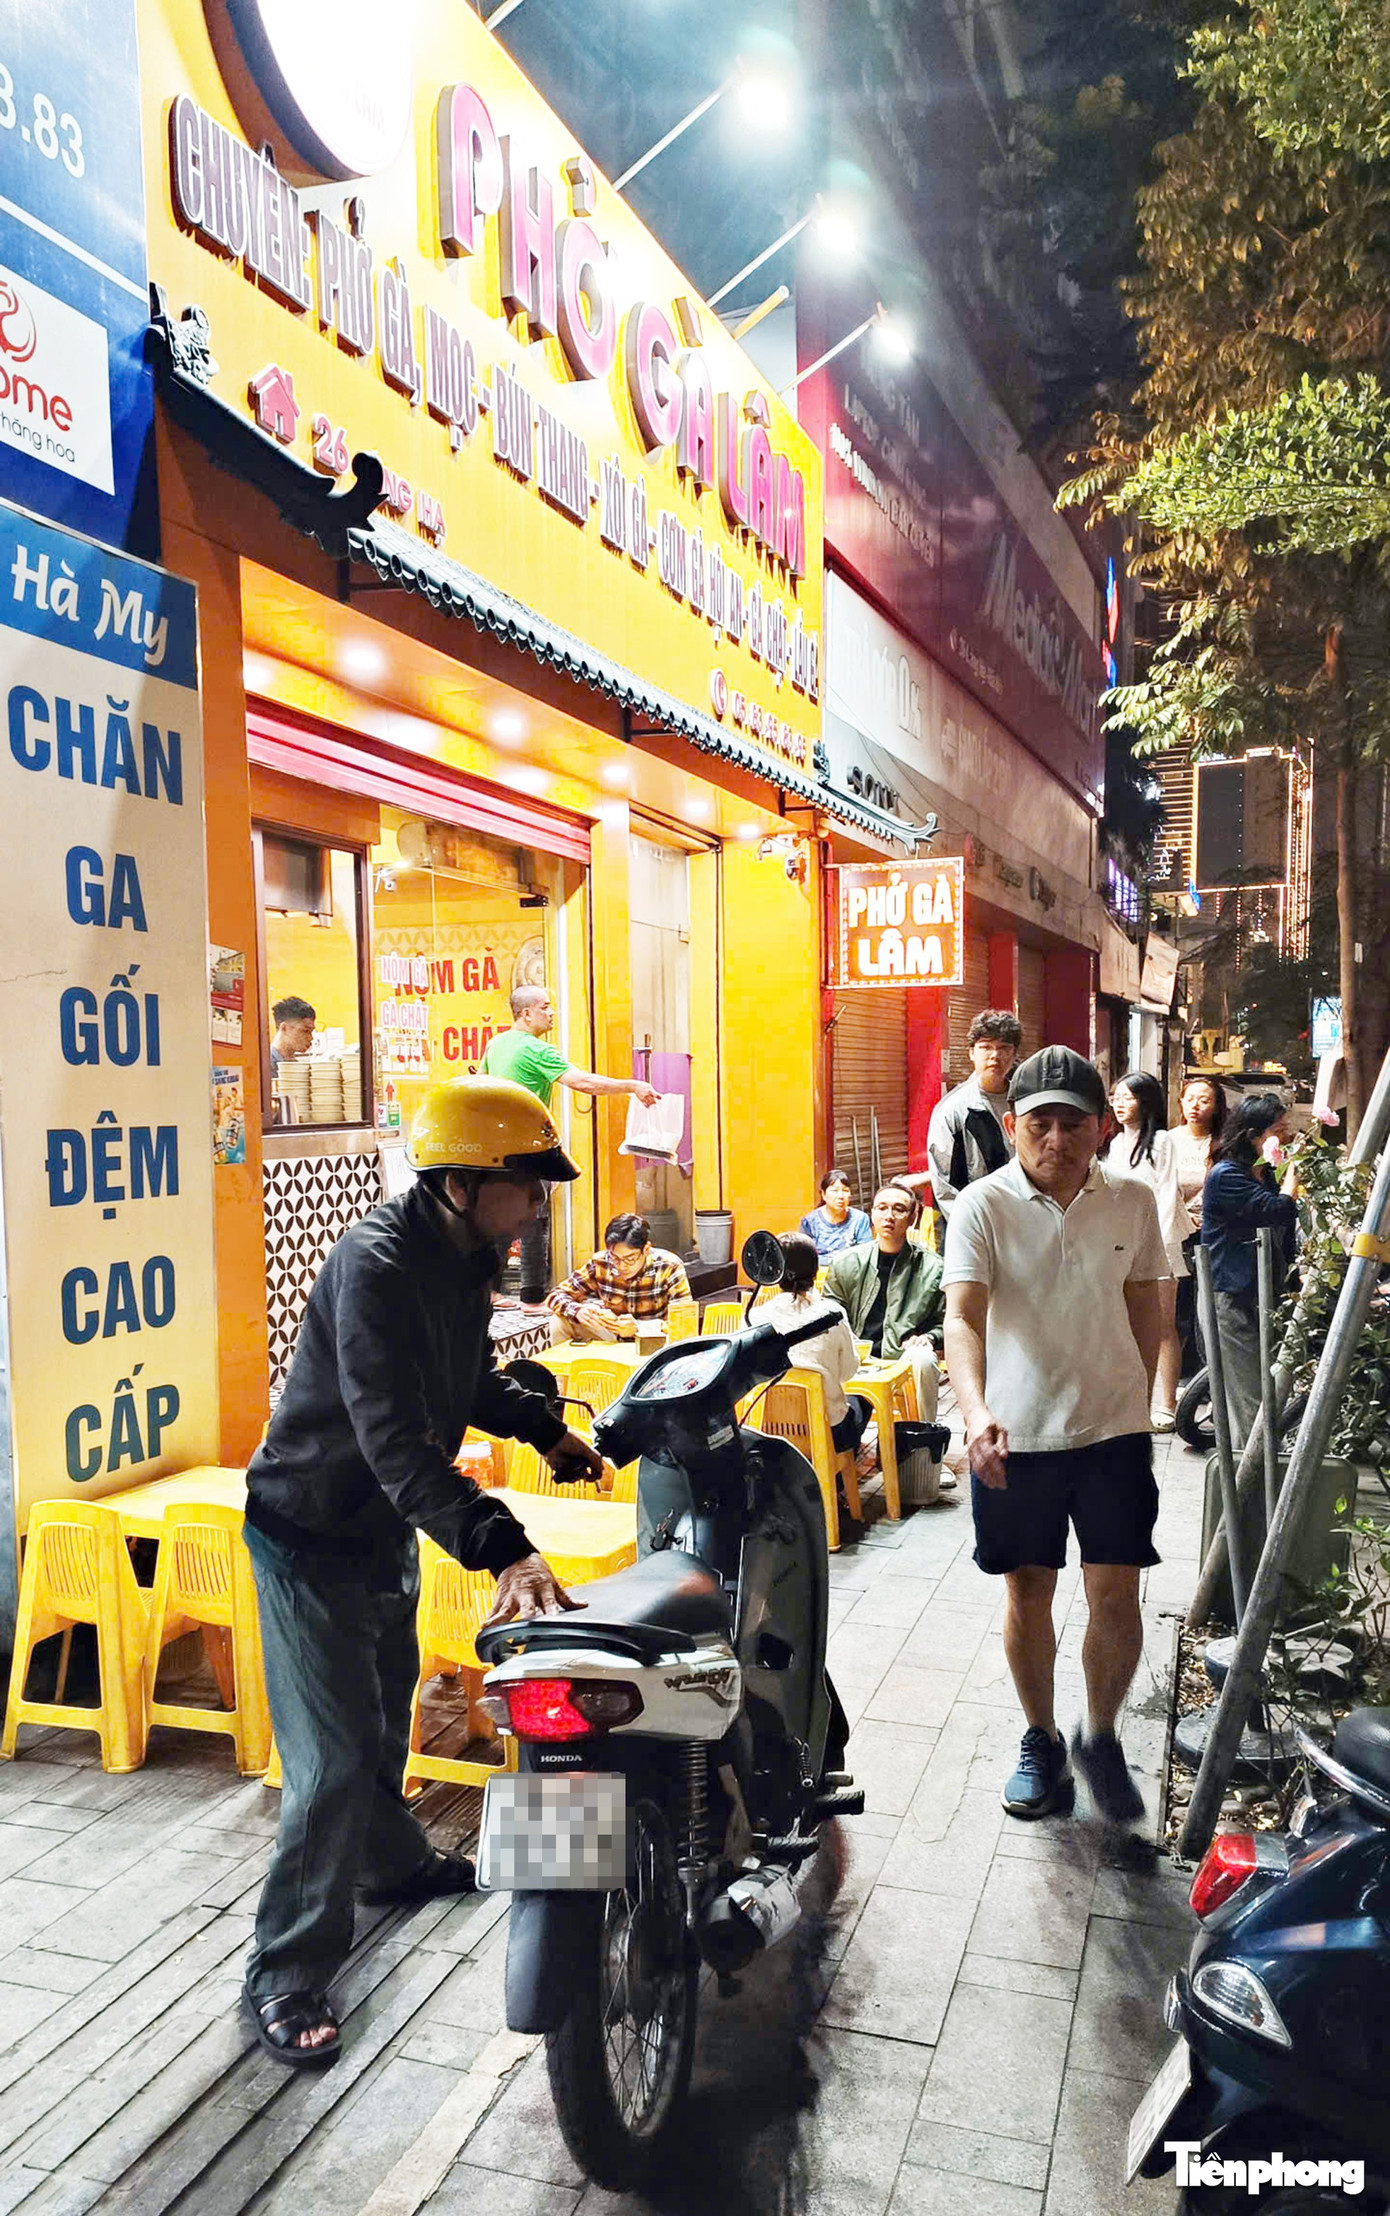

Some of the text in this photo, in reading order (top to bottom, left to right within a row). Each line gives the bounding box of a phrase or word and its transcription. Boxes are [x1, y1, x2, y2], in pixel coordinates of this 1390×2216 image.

[437, 82, 806, 581] PHỞ GÀ LÂM
[0, 410, 75, 463] hăng hoa
[312, 413, 349, 475] 26
[380, 467, 412, 513] NG
[316, 195, 374, 357] PHỞ
[493, 362, 533, 480] BÚN
[600, 453, 627, 551] XÔI
[659, 509, 688, 600] CƠM
[689, 526, 706, 612] GÀ
[707, 544, 726, 641] HỘI
[749, 581, 764, 658] GÀ
[11, 543, 168, 667] Hà My
[7, 684, 184, 806] CHĂN
[65, 845, 149, 933] GA
[849, 872, 907, 928] PHỞ
[912, 873, 954, 925] GÀ
[462, 946, 500, 992] GÀ
[857, 928, 944, 977] LÂM
[59, 963, 161, 1067] GỐI
[45, 1110, 180, 1220] ĐỆM
[426, 1142, 482, 1152] FEEL GOOD
[61, 1255, 176, 1345] CAO
[65, 1362, 180, 1484] CẤP
[540, 1754, 583, 1763] HONDA
